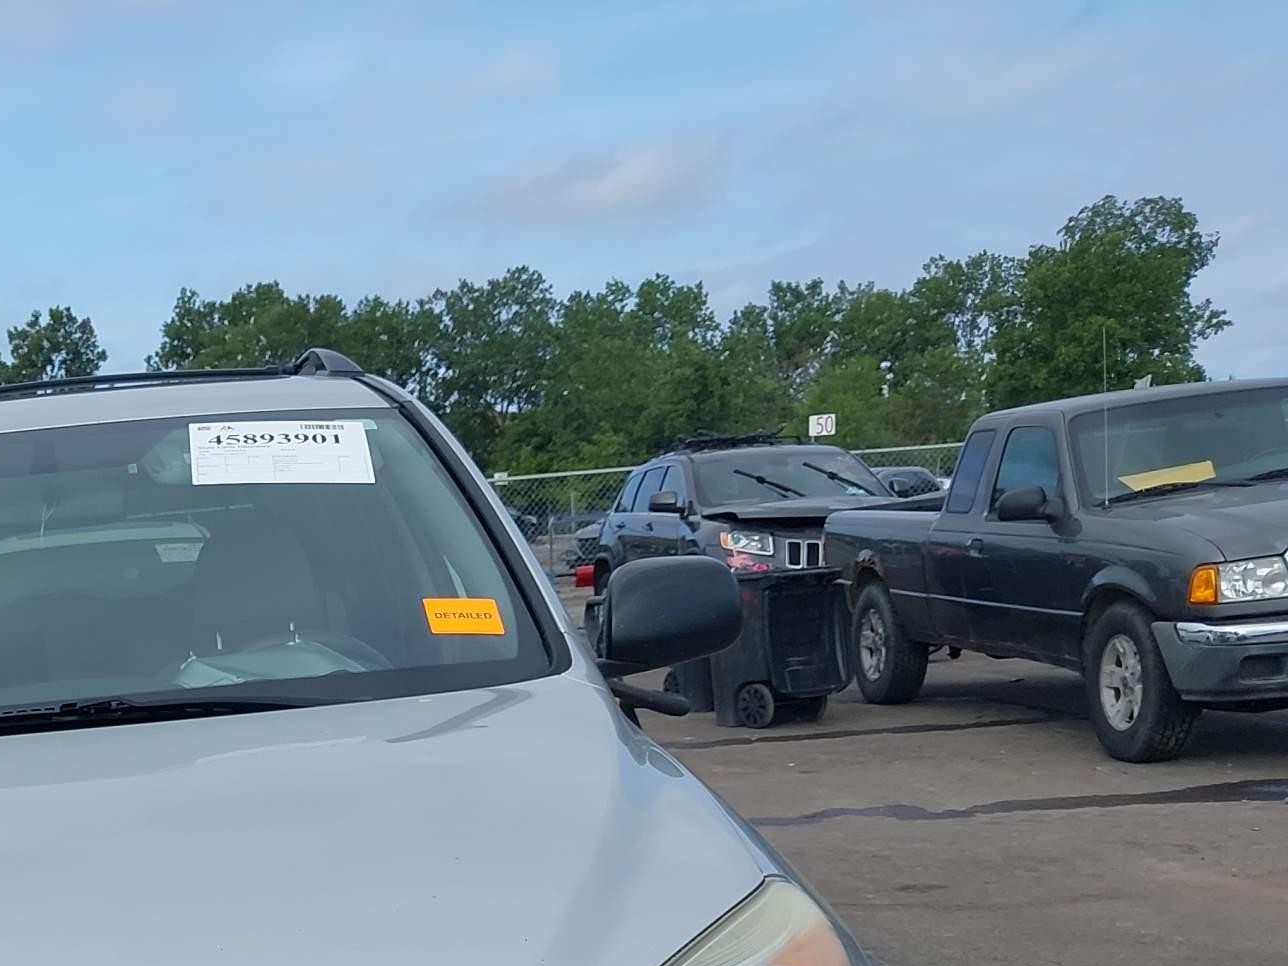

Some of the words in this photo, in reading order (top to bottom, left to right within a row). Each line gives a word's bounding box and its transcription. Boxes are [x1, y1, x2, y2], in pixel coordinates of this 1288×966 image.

[816, 416, 833, 434] 50
[207, 433, 343, 446] 45893901
[433, 612, 493, 620] DETAILED
